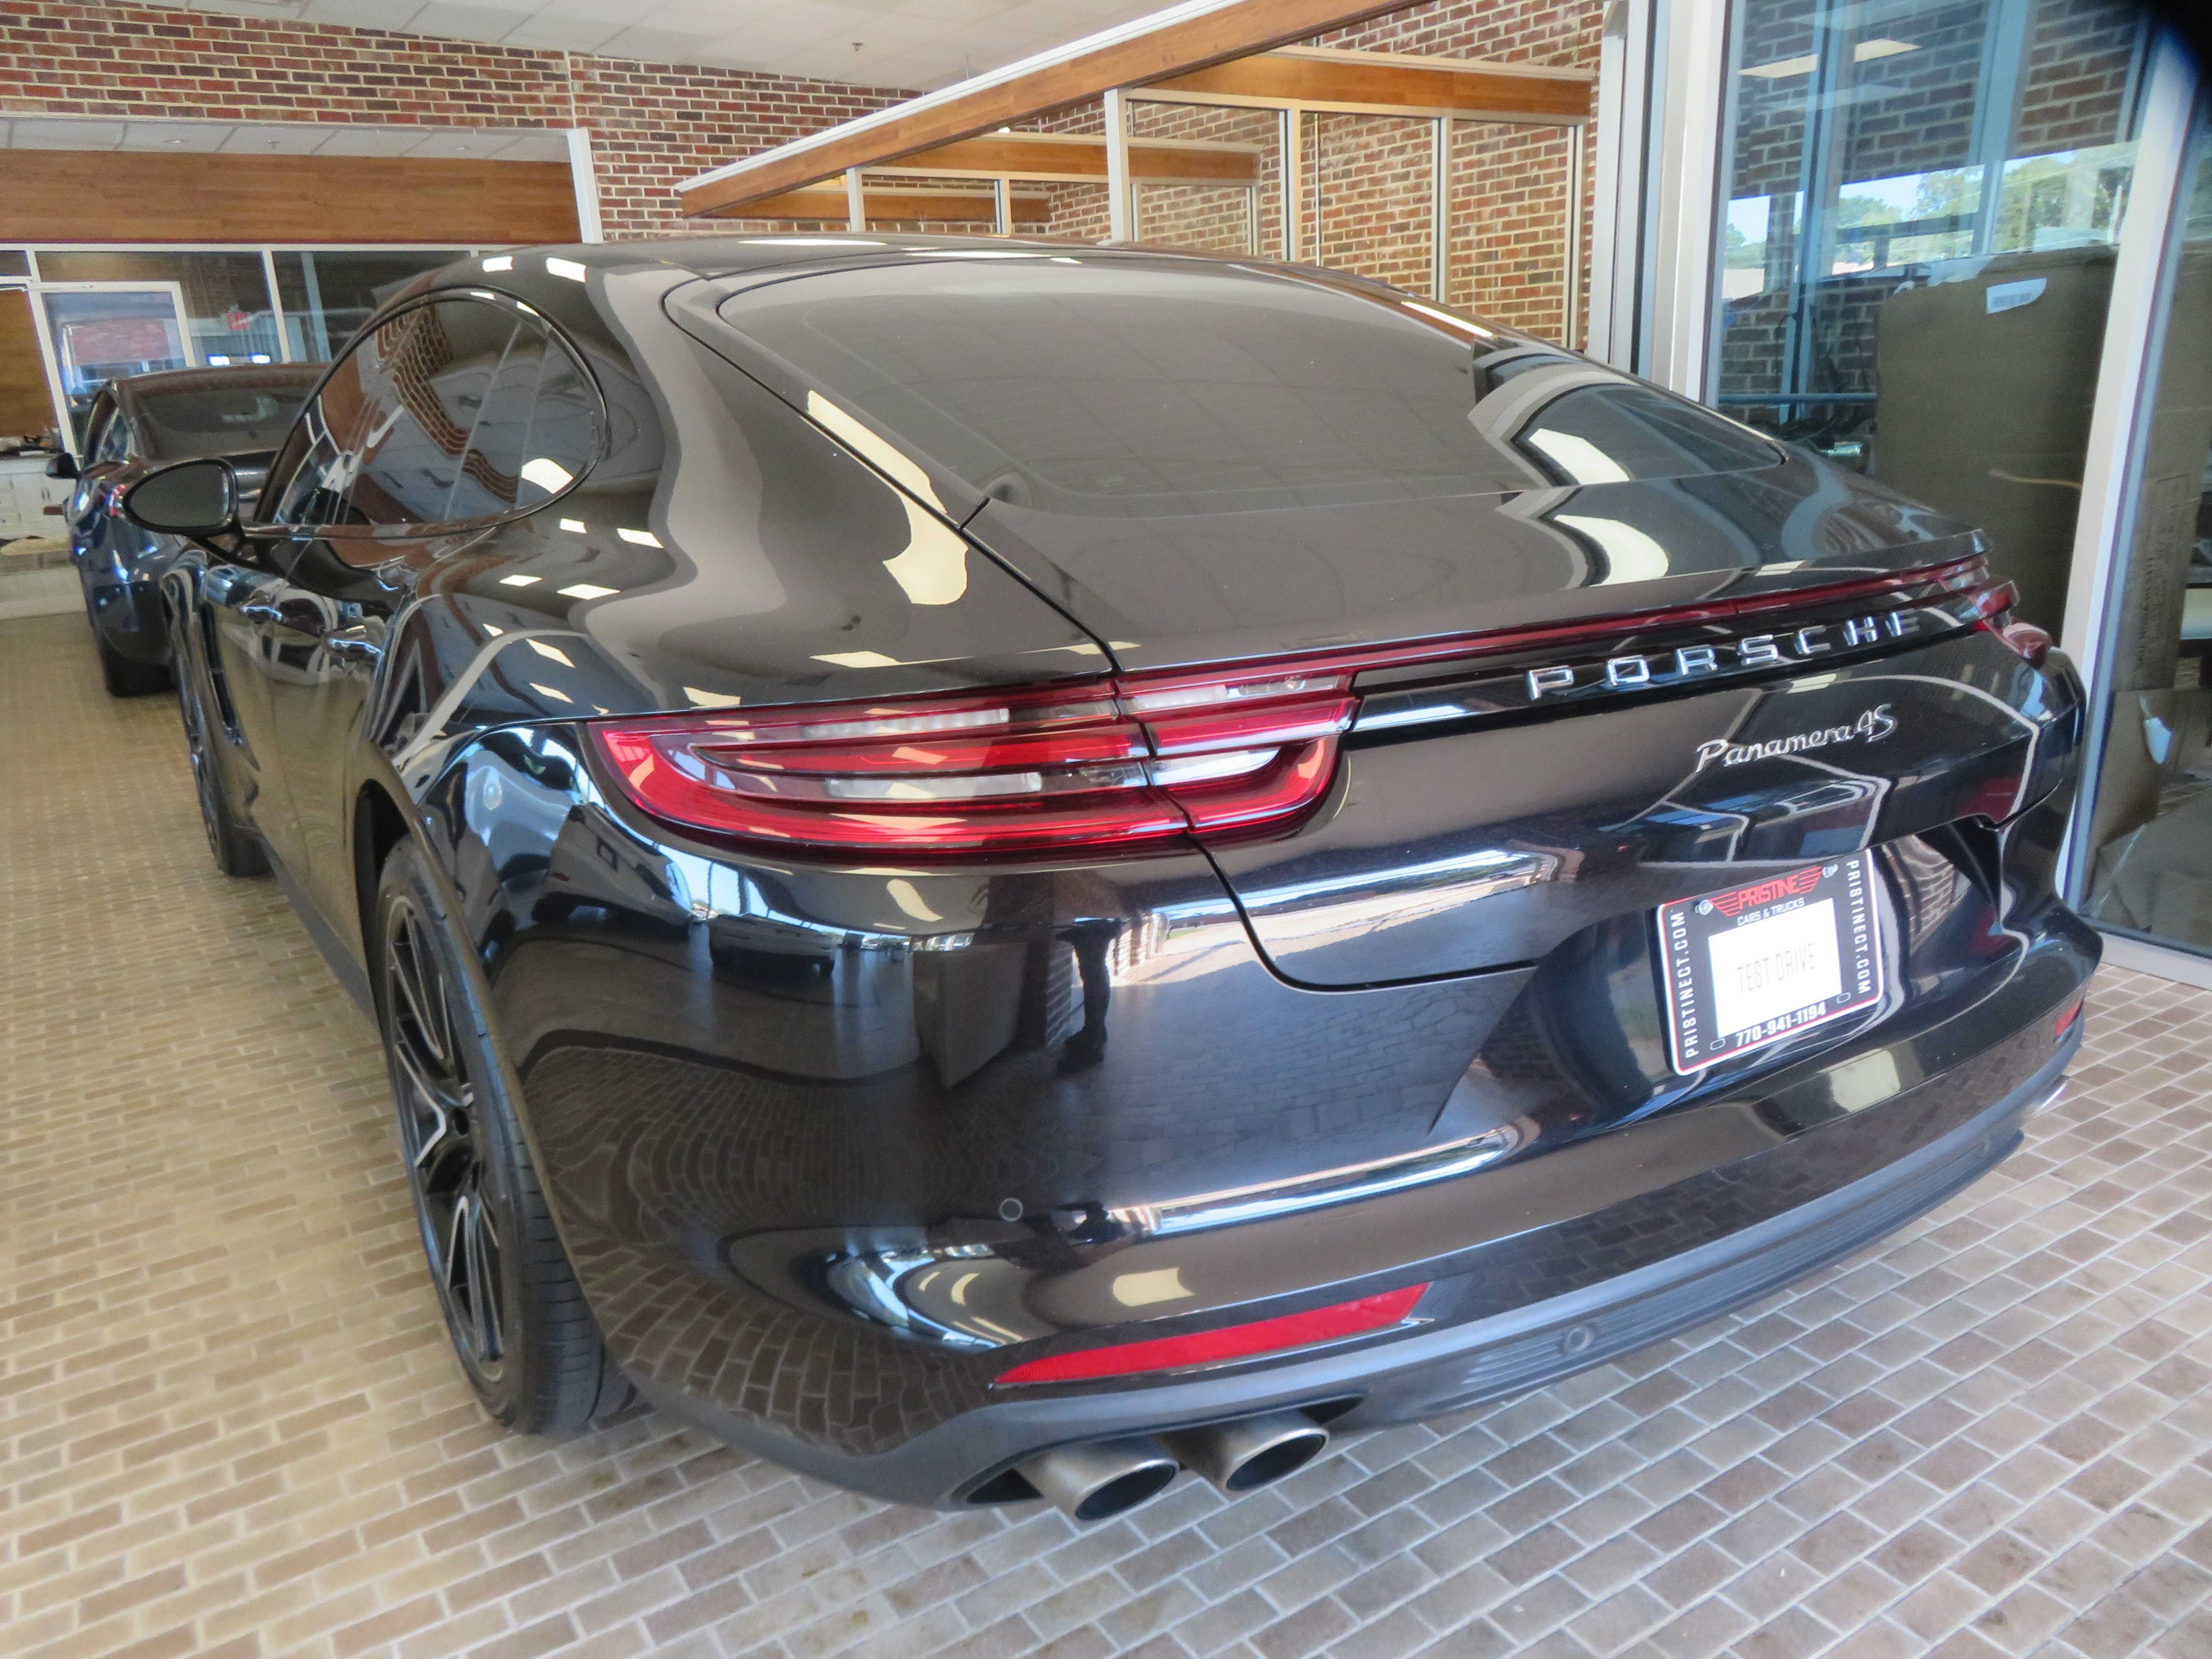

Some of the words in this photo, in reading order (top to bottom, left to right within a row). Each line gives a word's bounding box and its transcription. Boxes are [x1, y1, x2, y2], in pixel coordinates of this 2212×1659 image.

[1527, 610, 1920, 701] PORSCHE
[1694, 722, 1855, 774] Panamera
[1736, 909, 1761, 927] CARS
[1762, 908, 1770, 920] &
[1771, 896, 1805, 916] TRUCKS
[1737, 874, 1802, 910] PRISTINE
[1846, 859, 1871, 995] PRISTINECT.COM
[1670, 911, 1700, 1059] PRISTINECT.COM
[1736, 957, 1770, 994] TEST
[1775, 942, 1816, 982] DRIVE
[1735, 1001, 1827, 1048] 770-941-1194
